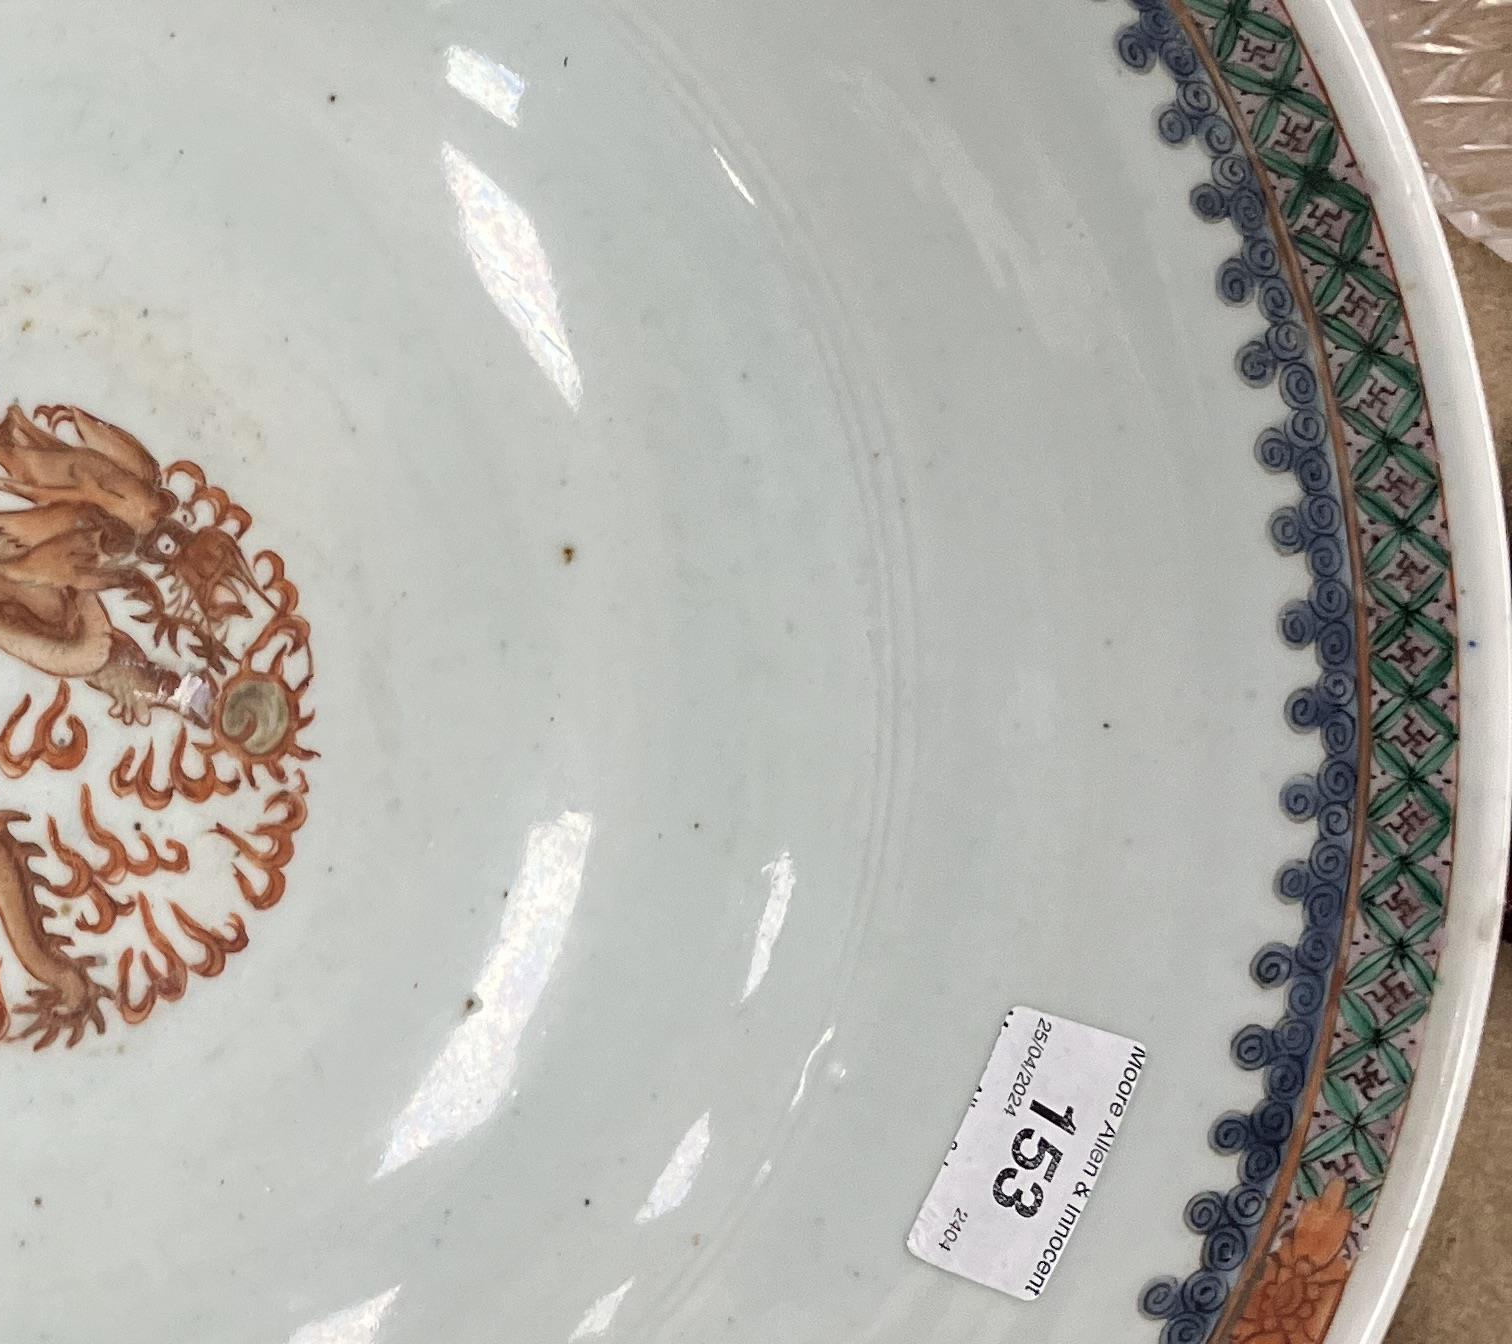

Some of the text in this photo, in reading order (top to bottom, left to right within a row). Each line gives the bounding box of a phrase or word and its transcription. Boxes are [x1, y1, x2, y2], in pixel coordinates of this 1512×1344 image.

[1003, 1017, 1052, 1117] 25/04/2024
[992, 1099, 1077, 1218] 153
[1024, 1045, 1147, 1296] Moore Allen & Innocent
[938, 1207, 968, 1252] 2404
